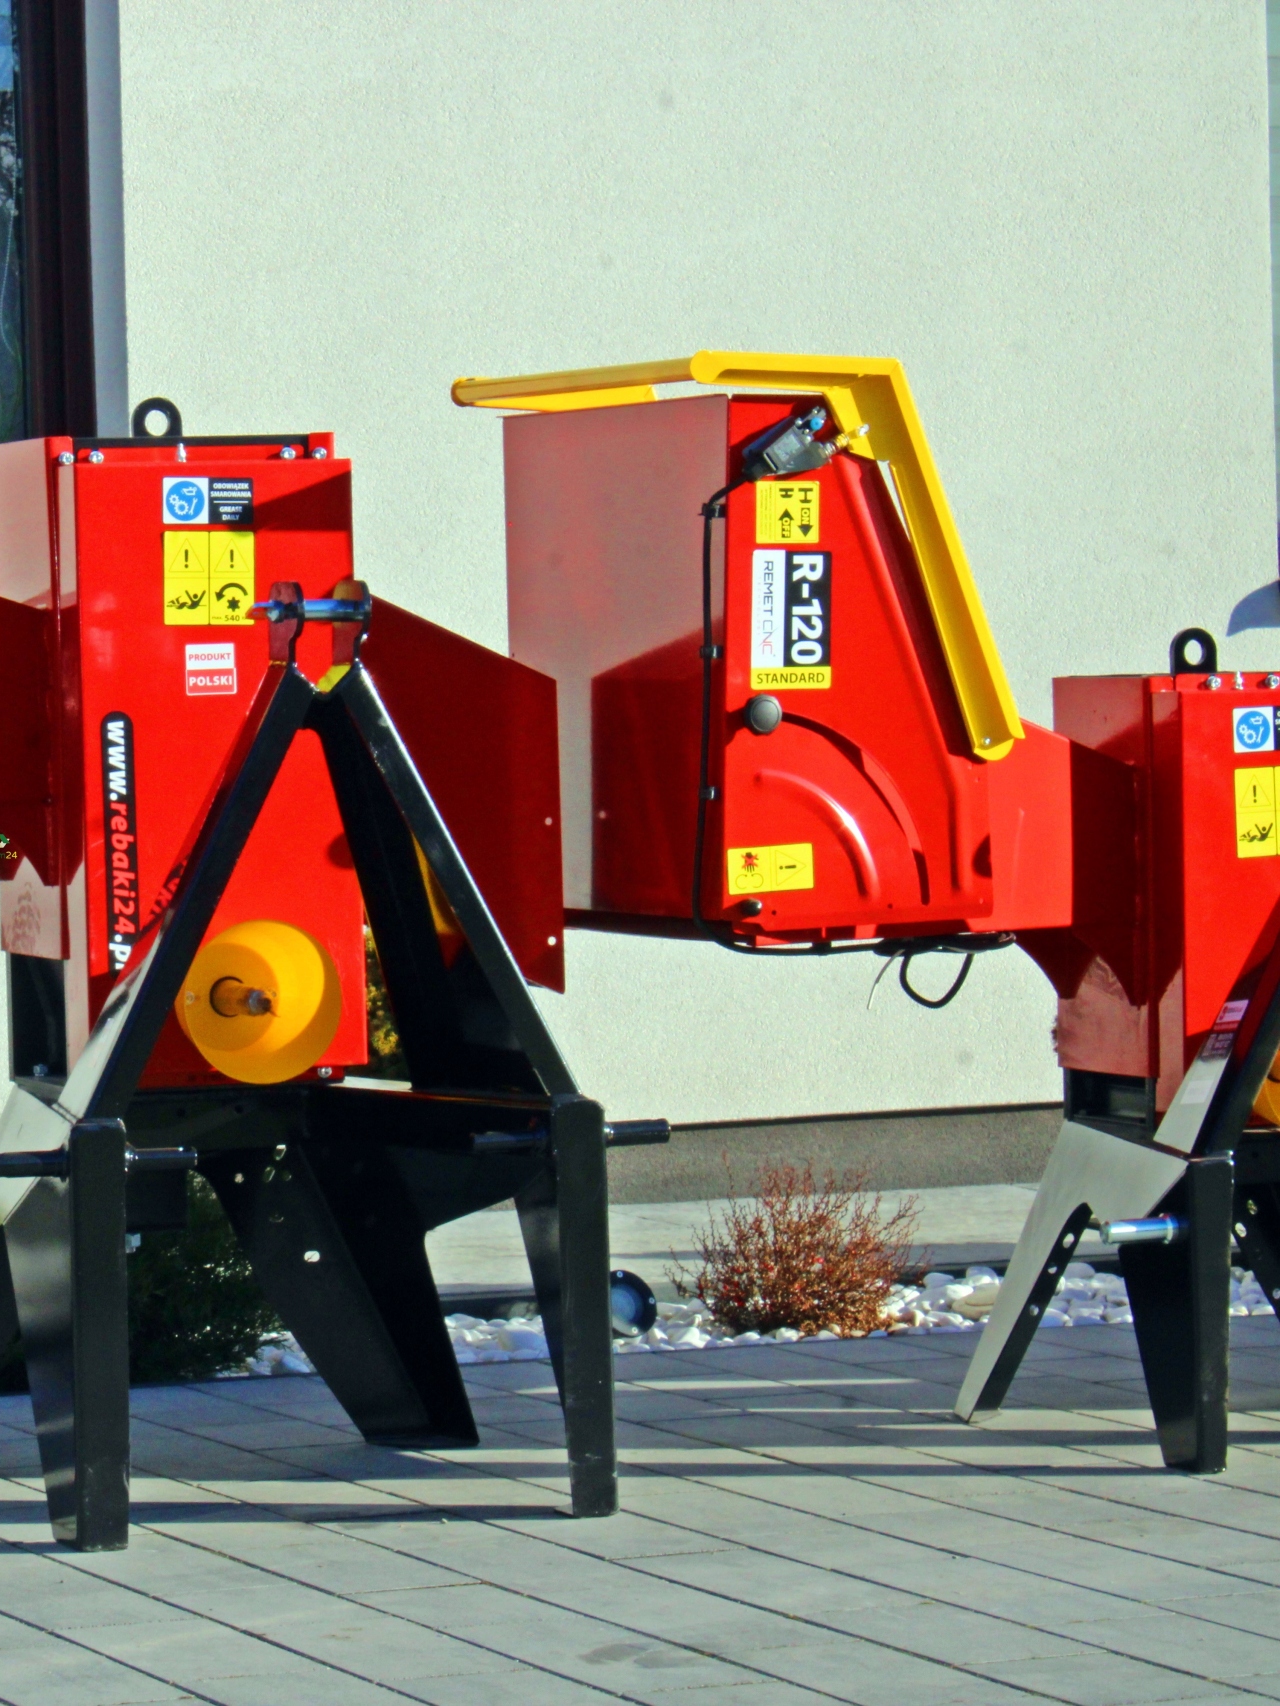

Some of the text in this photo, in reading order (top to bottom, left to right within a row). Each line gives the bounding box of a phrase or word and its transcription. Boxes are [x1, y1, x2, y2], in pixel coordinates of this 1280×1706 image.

[212, 482, 250, 491] OBOWIĄZEK
[210, 490, 252, 498] SMAROWANIA
[219, 505, 243, 513] GREASE
[801, 508, 811, 525] ON
[782, 517, 791, 538] OFF
[762, 560, 774, 655] REMET CNC
[790, 554, 824, 665] R-120
[224, 614, 241, 622] 540
[188, 652, 232, 662] PRODUKT
[188, 675, 233, 687] POLSKI
[756, 672, 825, 685] STANDARD
